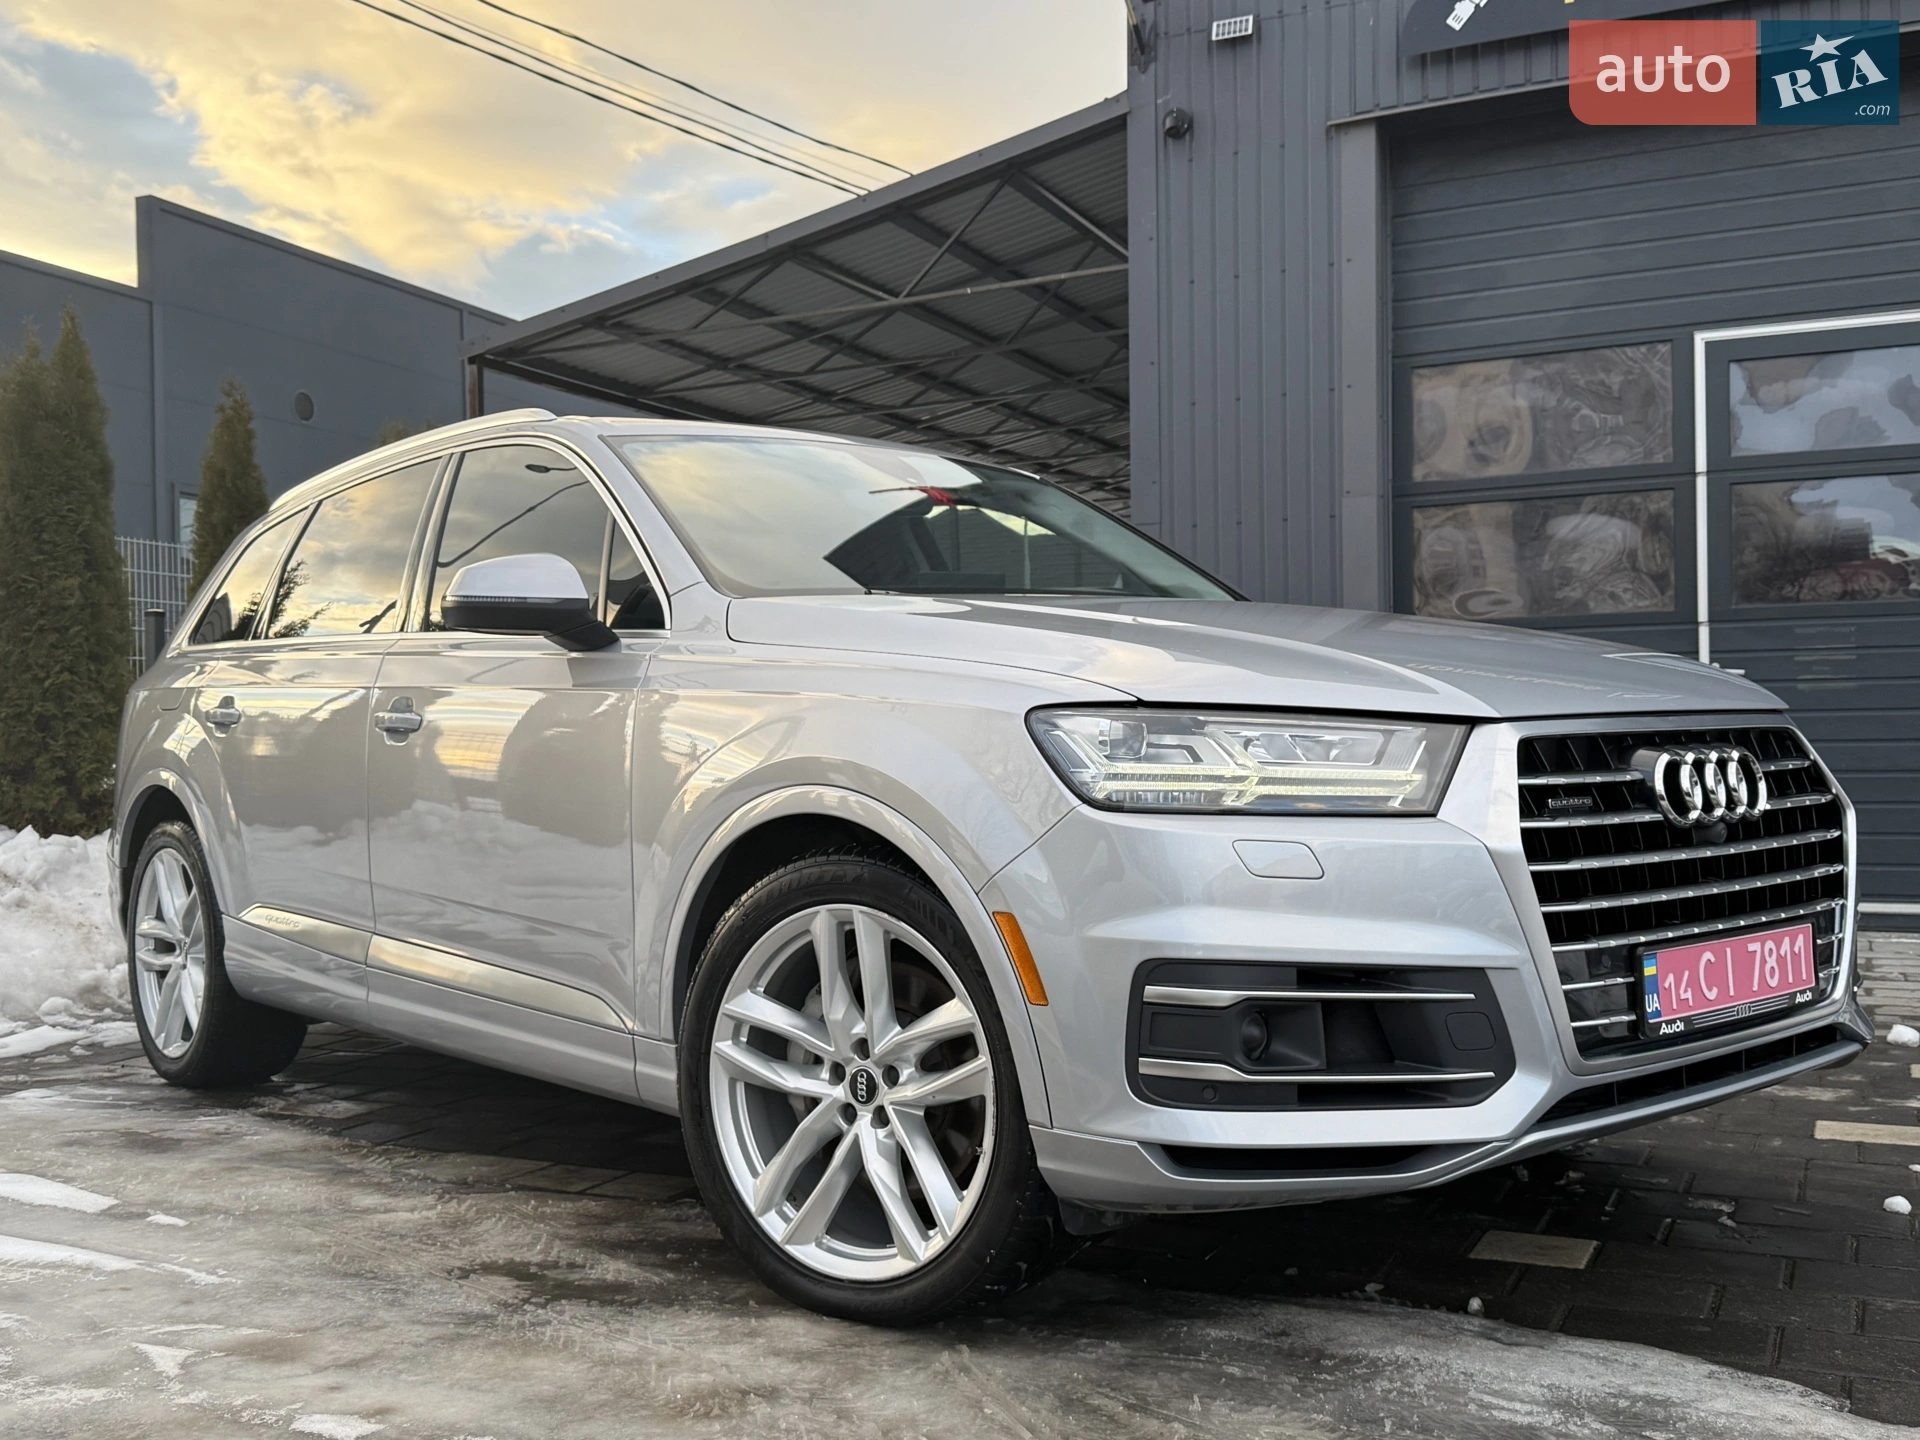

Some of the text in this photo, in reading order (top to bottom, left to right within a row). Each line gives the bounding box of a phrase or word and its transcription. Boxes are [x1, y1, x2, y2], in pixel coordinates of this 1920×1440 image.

[1551, 797, 1591, 808] quattro
[265, 914, 301, 928] quattro
[1663, 970, 1693, 1010] 14
[1747, 933, 1807, 992] 7811
[1645, 993, 1661, 1013] UA
[1795, 990, 1812, 1004] Audi
[1659, 1019, 1685, 1035] Audi
